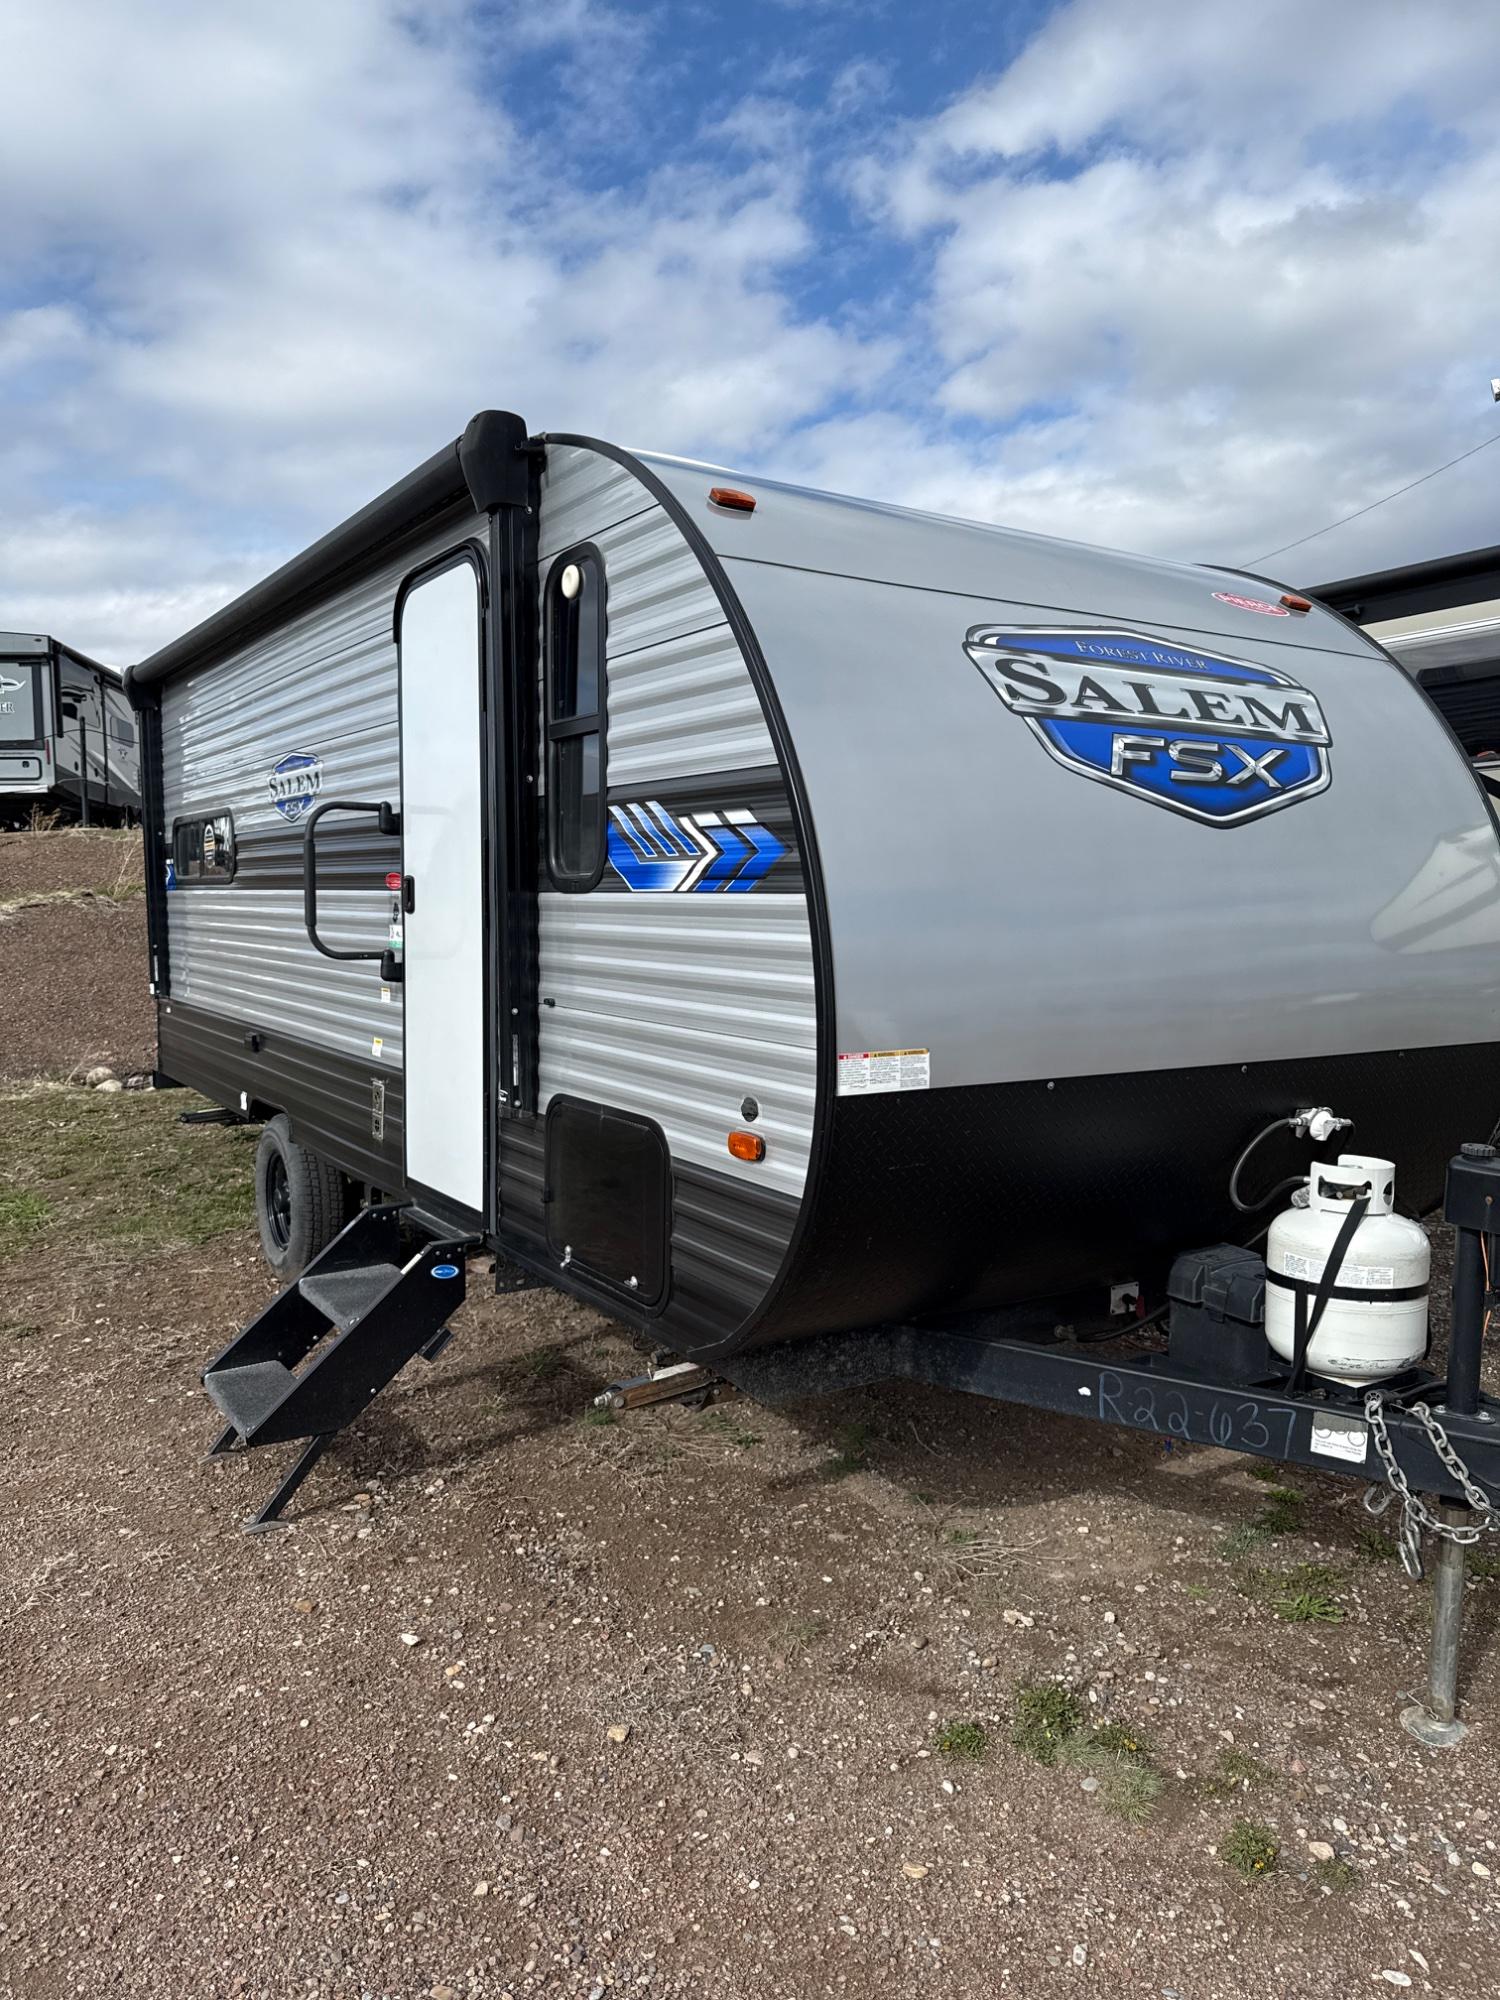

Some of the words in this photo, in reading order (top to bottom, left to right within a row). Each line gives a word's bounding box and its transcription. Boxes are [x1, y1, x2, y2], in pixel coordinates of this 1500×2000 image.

[1074, 640, 1148, 662] FOREST
[1152, 651, 1209, 670] RIVER
[994, 657, 1322, 733] SALEM
[1110, 732, 1287, 789] FSX
[269, 771, 320, 798] SALEM
